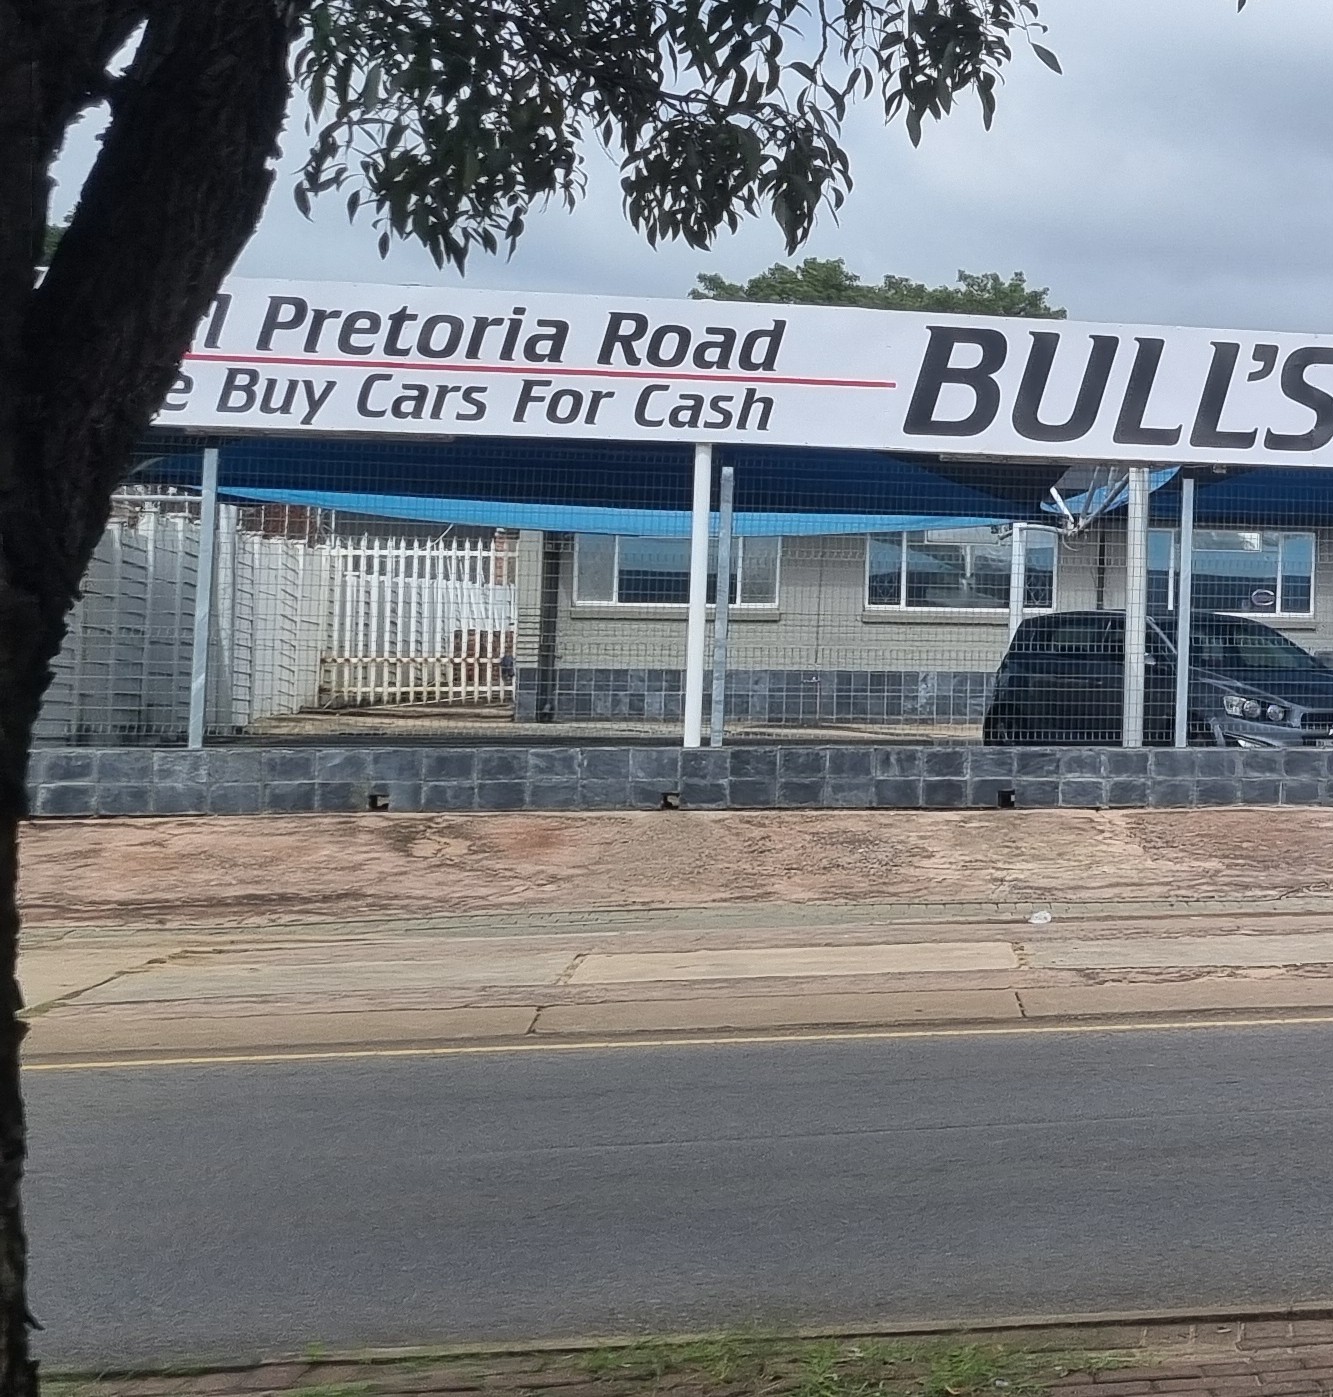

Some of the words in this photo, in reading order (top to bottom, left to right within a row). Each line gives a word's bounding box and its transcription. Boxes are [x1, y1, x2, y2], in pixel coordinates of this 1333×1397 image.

[255, 295, 570, 363] Pretoria
[596, 311, 787, 372] Road
[161, 371, 194, 412] e
[215, 367, 338, 425] Buy
[356, 373, 489, 422] Cars
[512, 378, 616, 425] For
[634, 383, 775, 431] Cash
